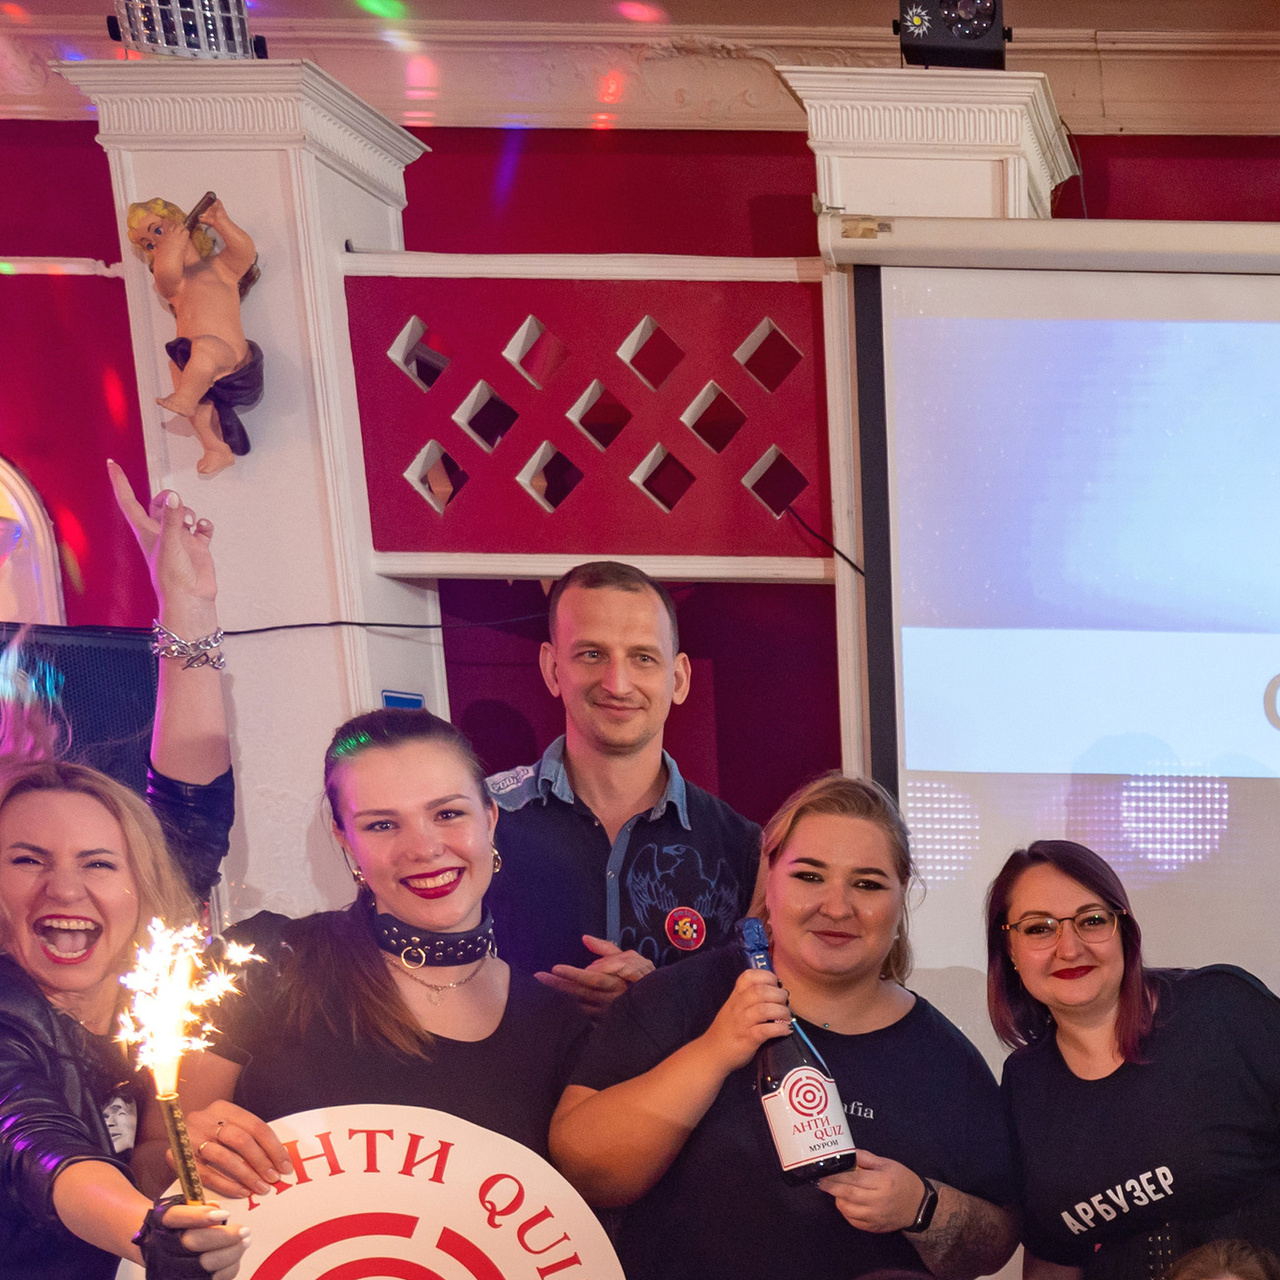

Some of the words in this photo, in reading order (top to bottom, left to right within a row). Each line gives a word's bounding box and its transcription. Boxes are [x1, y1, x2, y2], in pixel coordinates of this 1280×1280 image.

[792, 1116, 831, 1135] АНТИ
[814, 1125, 844, 1141] QUIZ
[808, 1139, 839, 1152] МУРОМ
[1061, 1165, 1174, 1235] АРБУЗЕР
